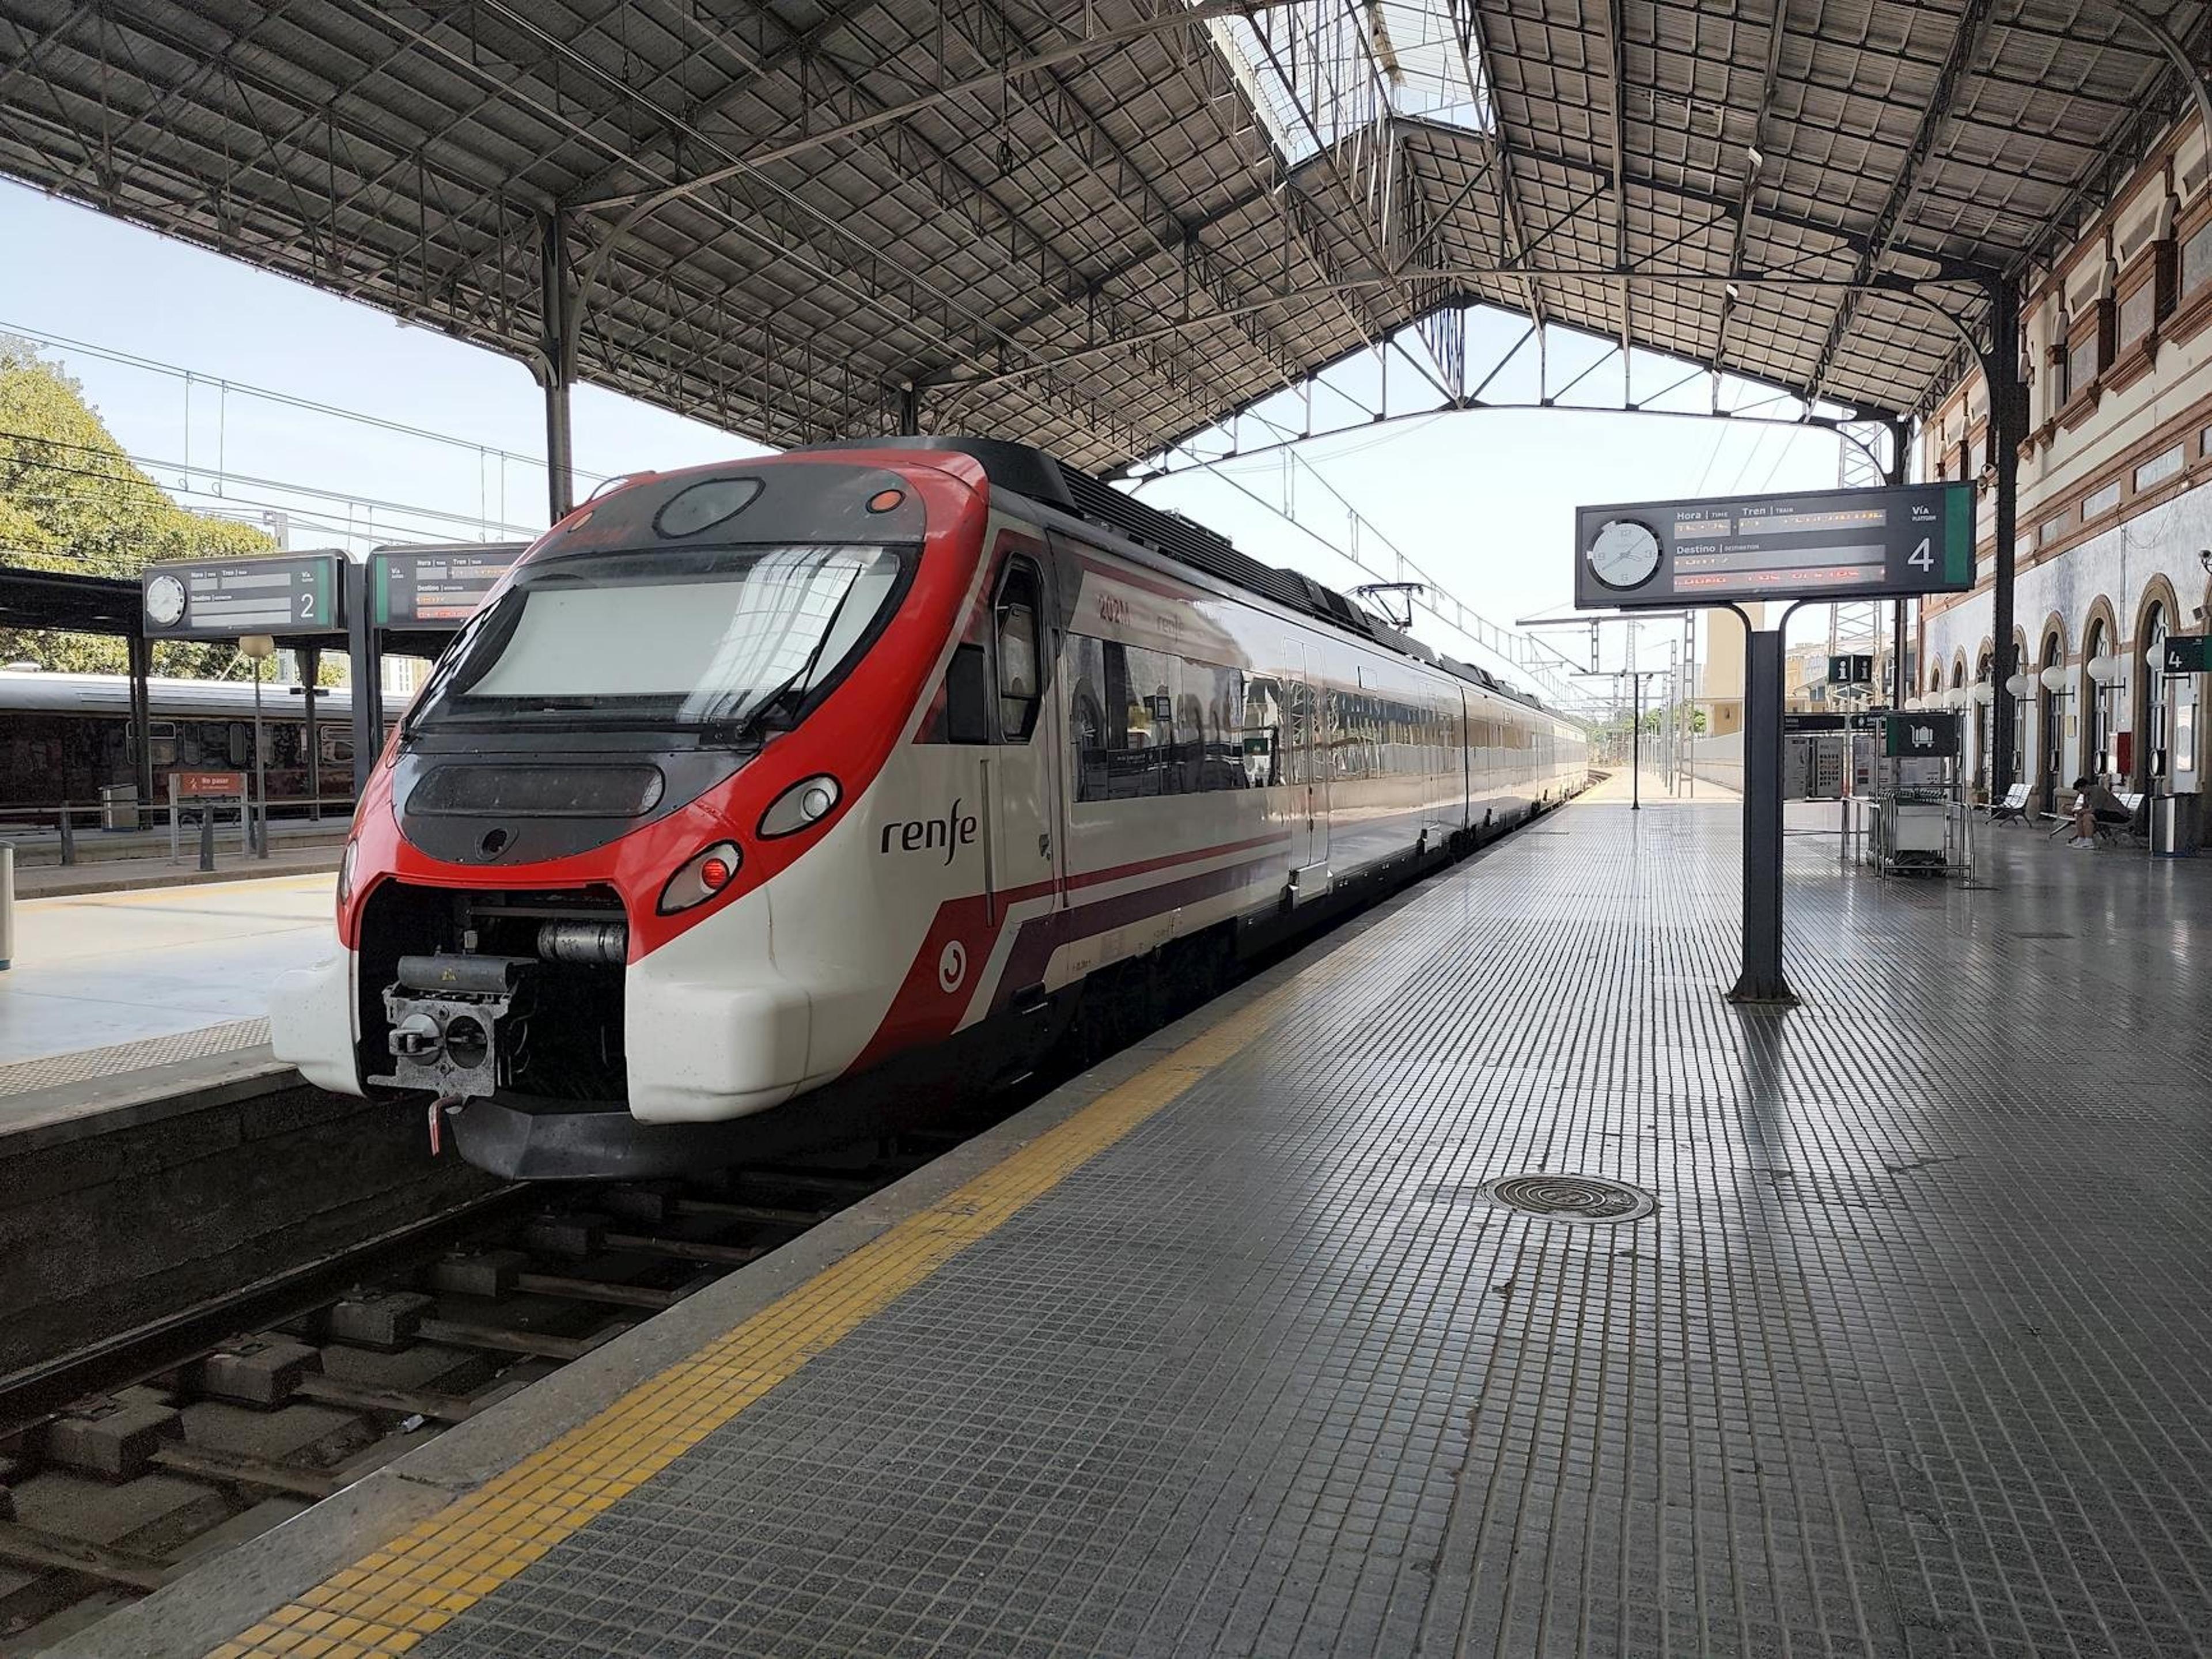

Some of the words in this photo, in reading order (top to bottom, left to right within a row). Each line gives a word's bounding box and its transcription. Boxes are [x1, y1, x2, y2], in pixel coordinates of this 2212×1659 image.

[1676, 511, 1701, 520] Hora
[1742, 507, 1766, 516] Tren
[1676, 544, 1716, 555] Destino
[1907, 537, 1934, 572] 4
[300, 593, 314, 618] 2
[1157, 613, 1185, 643] renfe
[2168, 651, 2183, 668] 4
[881, 797, 978, 867] renfe
